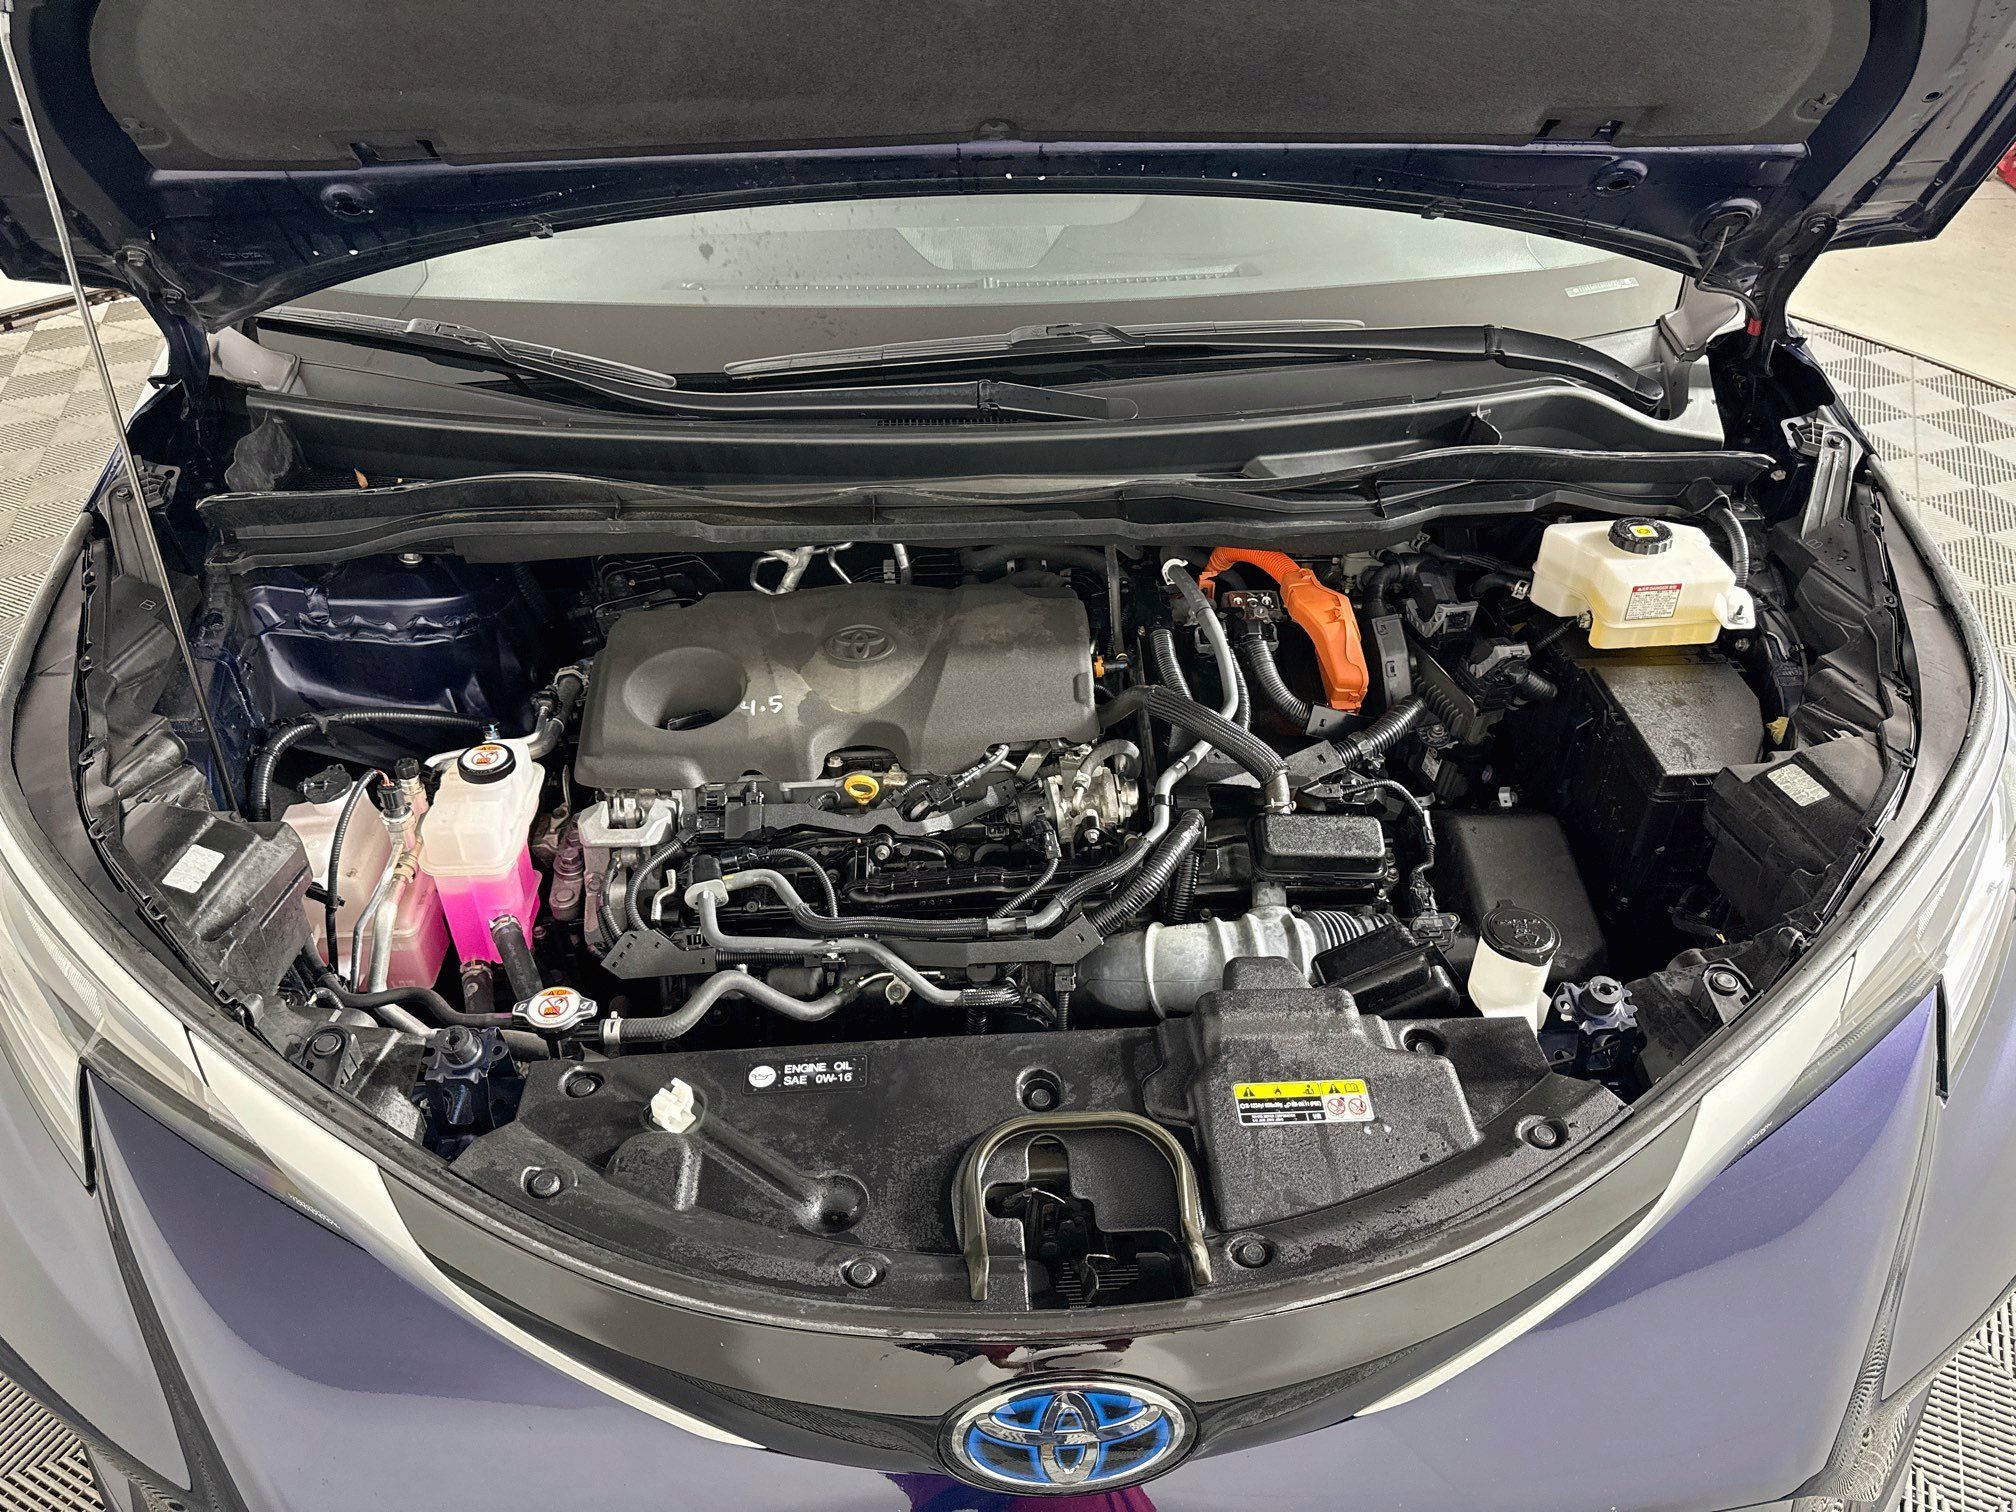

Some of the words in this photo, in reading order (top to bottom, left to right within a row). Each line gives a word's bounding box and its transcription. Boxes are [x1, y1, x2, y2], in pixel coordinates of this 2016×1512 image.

[740, 695, 783, 716] 4.5
[784, 1062, 827, 1074] ENGINE
[834, 1061, 853, 1071] OIL
[783, 1075, 808, 1085] SAE
[815, 1072, 853, 1083] 0W-16
